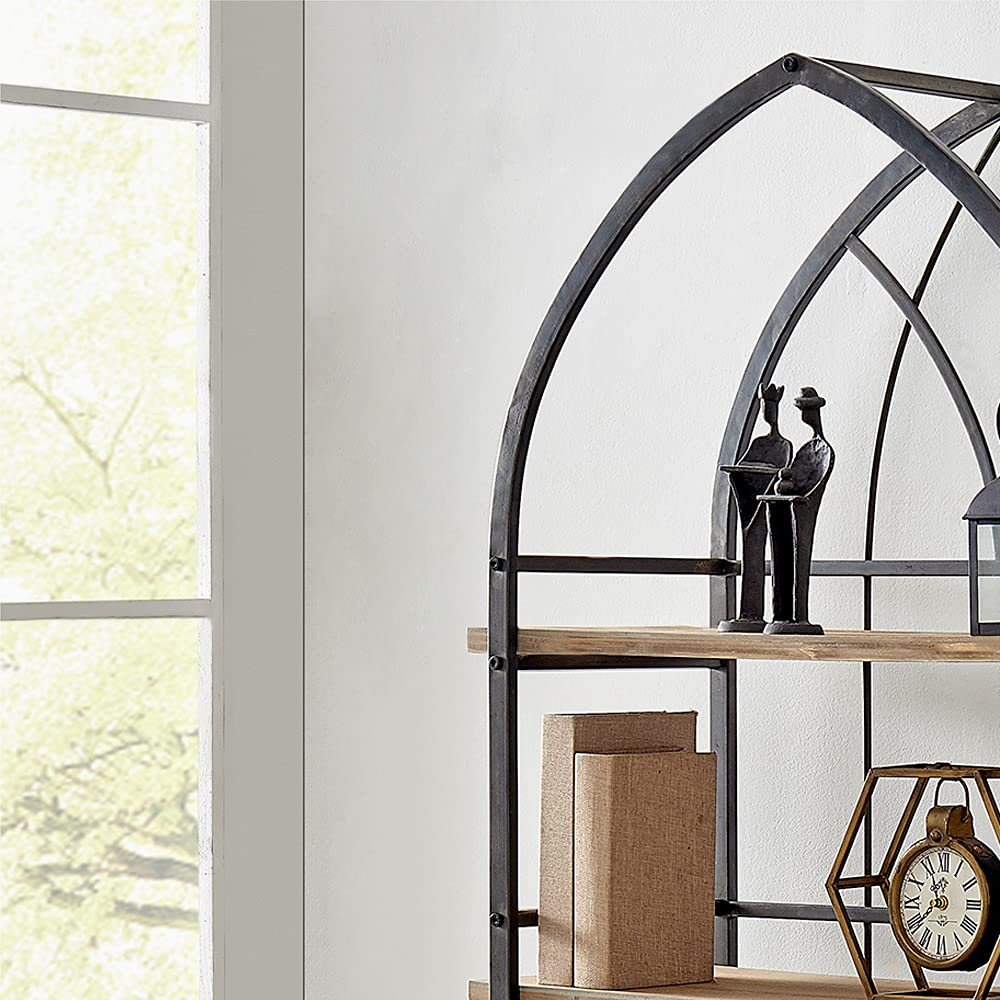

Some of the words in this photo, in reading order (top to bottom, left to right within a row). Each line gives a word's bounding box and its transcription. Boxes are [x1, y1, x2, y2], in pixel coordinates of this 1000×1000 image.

[937, 853, 950, 873] XII
[954, 860, 964, 877] I
[908, 873, 925, 891] X
[962, 876, 978, 892] II
[904, 895, 920, 909] IX
[966, 899, 982, 911] III
[960, 914, 978, 936] IIII
[936, 934, 947, 955] VI
[953, 931, 964, 951] V
